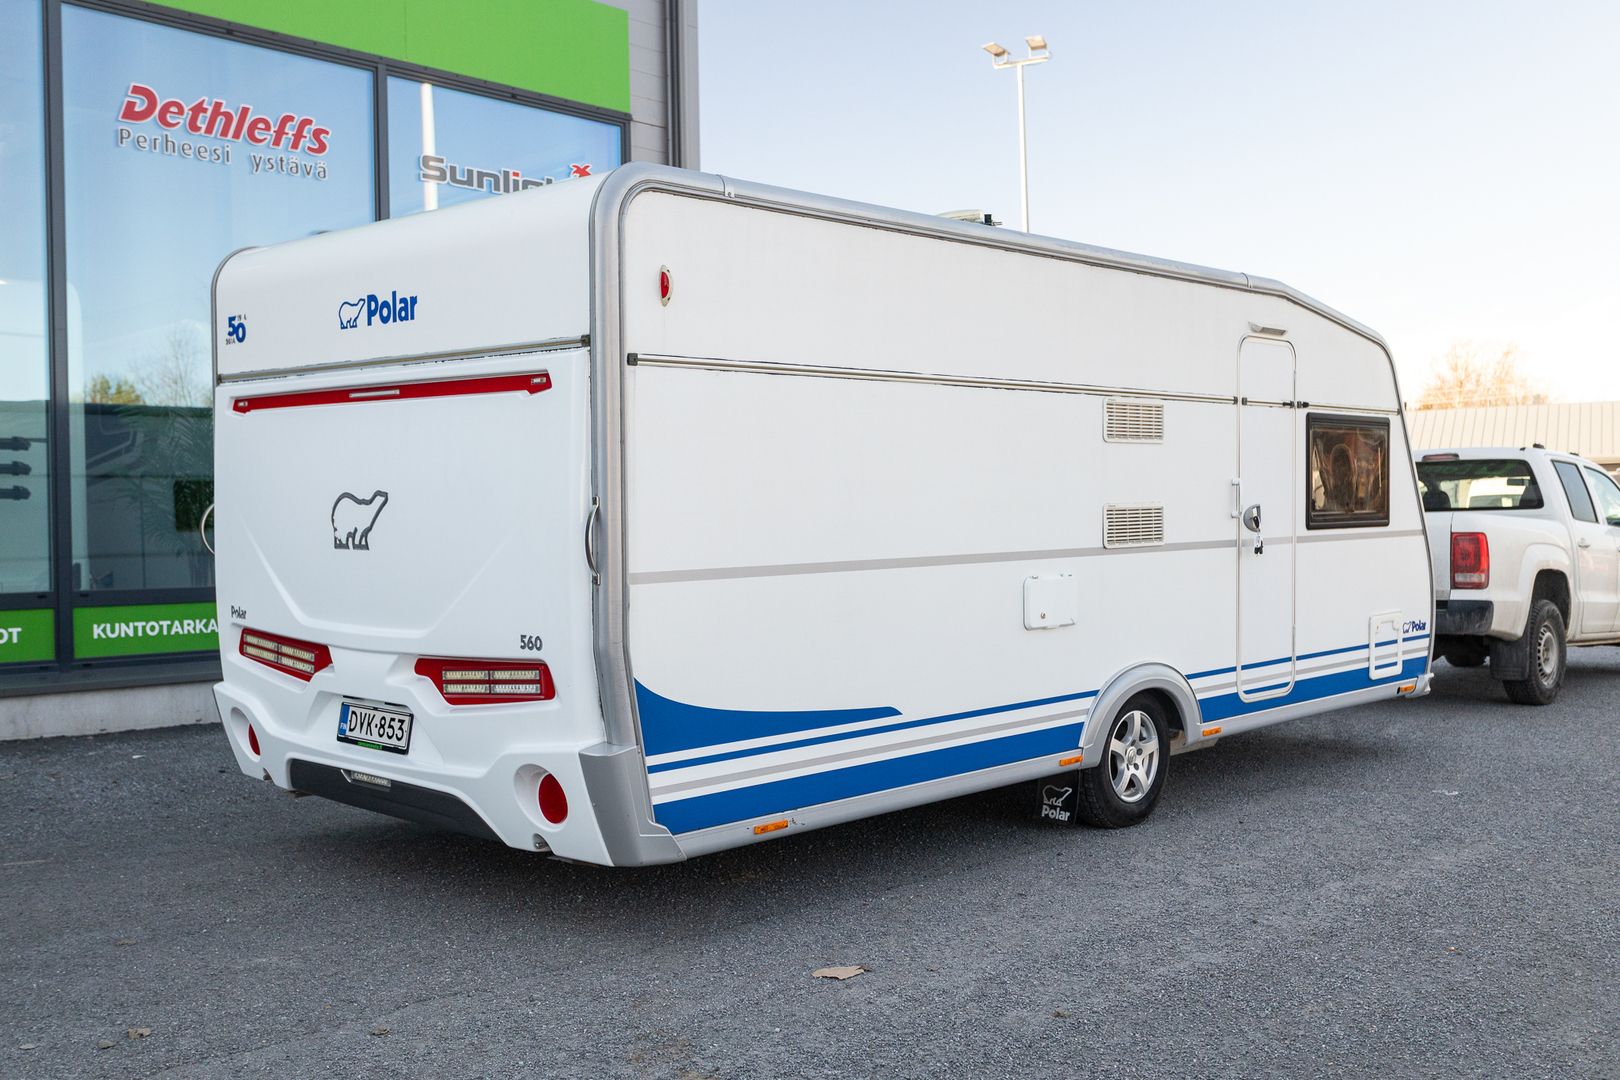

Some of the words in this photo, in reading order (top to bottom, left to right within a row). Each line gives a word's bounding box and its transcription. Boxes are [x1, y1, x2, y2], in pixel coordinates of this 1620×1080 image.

[119, 84, 331, 155] Dethleffs
[118, 128, 231, 162] Perheesi
[251, 154, 327, 179] ystävä
[366, 290, 418, 326] Polar
[227, 316, 247, 343] 50
[231, 605, 247, 619] Polar
[1411, 620, 1427, 632] Polar
[520, 634, 543, 651] 560
[348, 710, 406, 741] DVK-853
[1041, 804, 1070, 821] Polar
